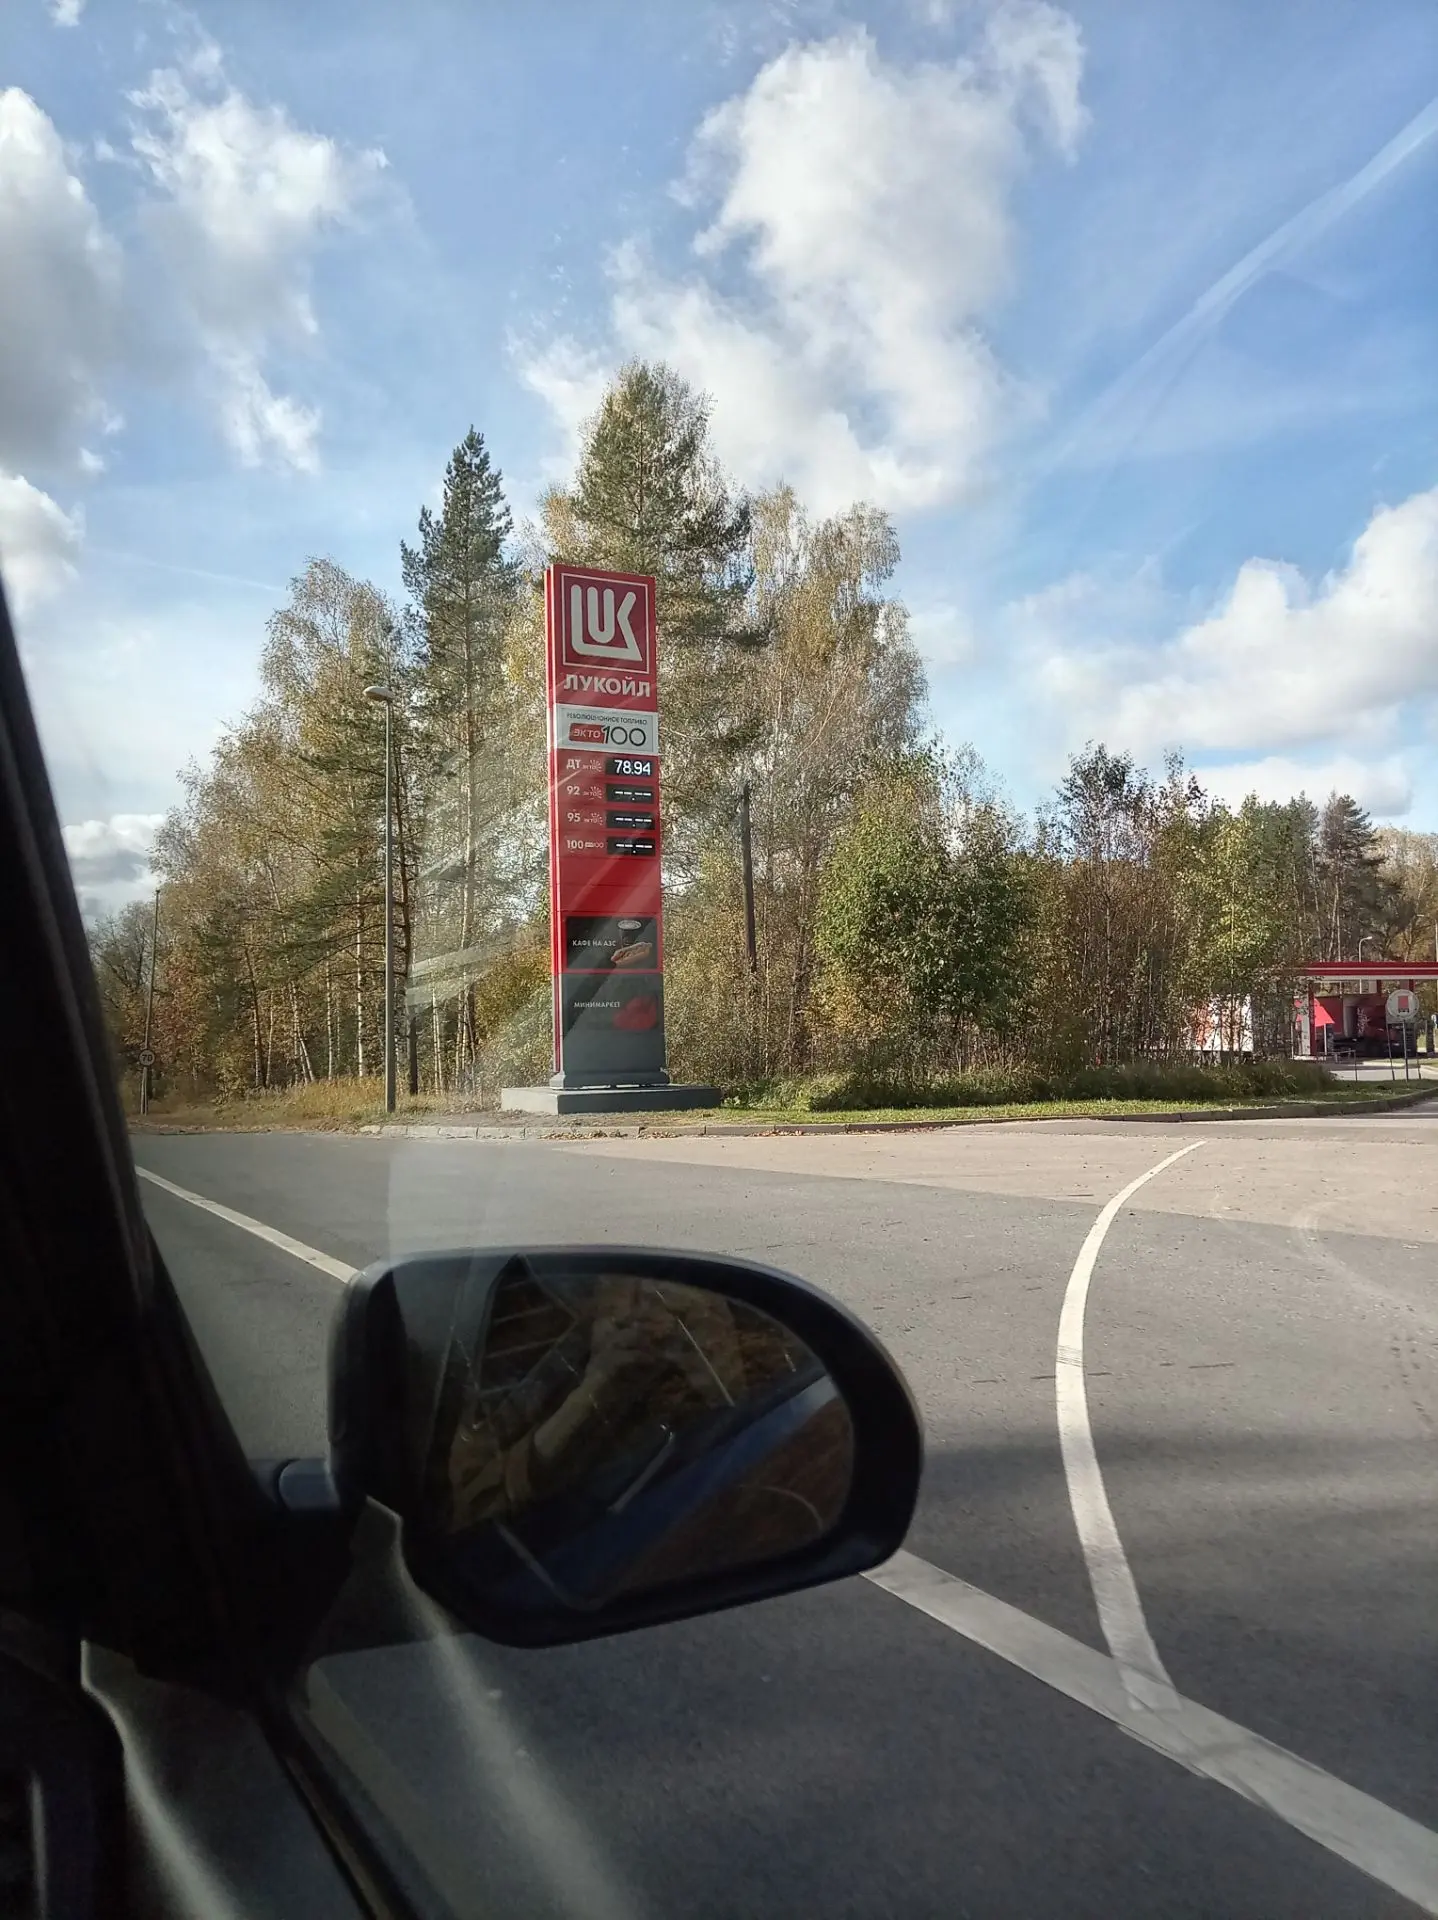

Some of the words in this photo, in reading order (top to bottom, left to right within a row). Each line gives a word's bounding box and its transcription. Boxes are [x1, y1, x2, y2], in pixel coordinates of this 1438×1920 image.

[563, 673, 650, 697] ЛУКОЙЛ
[573, 728, 601, 738] ЭКТО
[601, 725, 646, 746] 100
[566, 758, 581, 770] ДТ
[614, 759, 651, 776] 78.94
[566, 785, 580, 795] 92
[567, 812, 581, 822] 95
[566, 839, 583, 849] 100
[592, 939, 602, 947] НА
[603, 939, 616, 947] АЗС
[142, 1054, 153, 1062] 70
